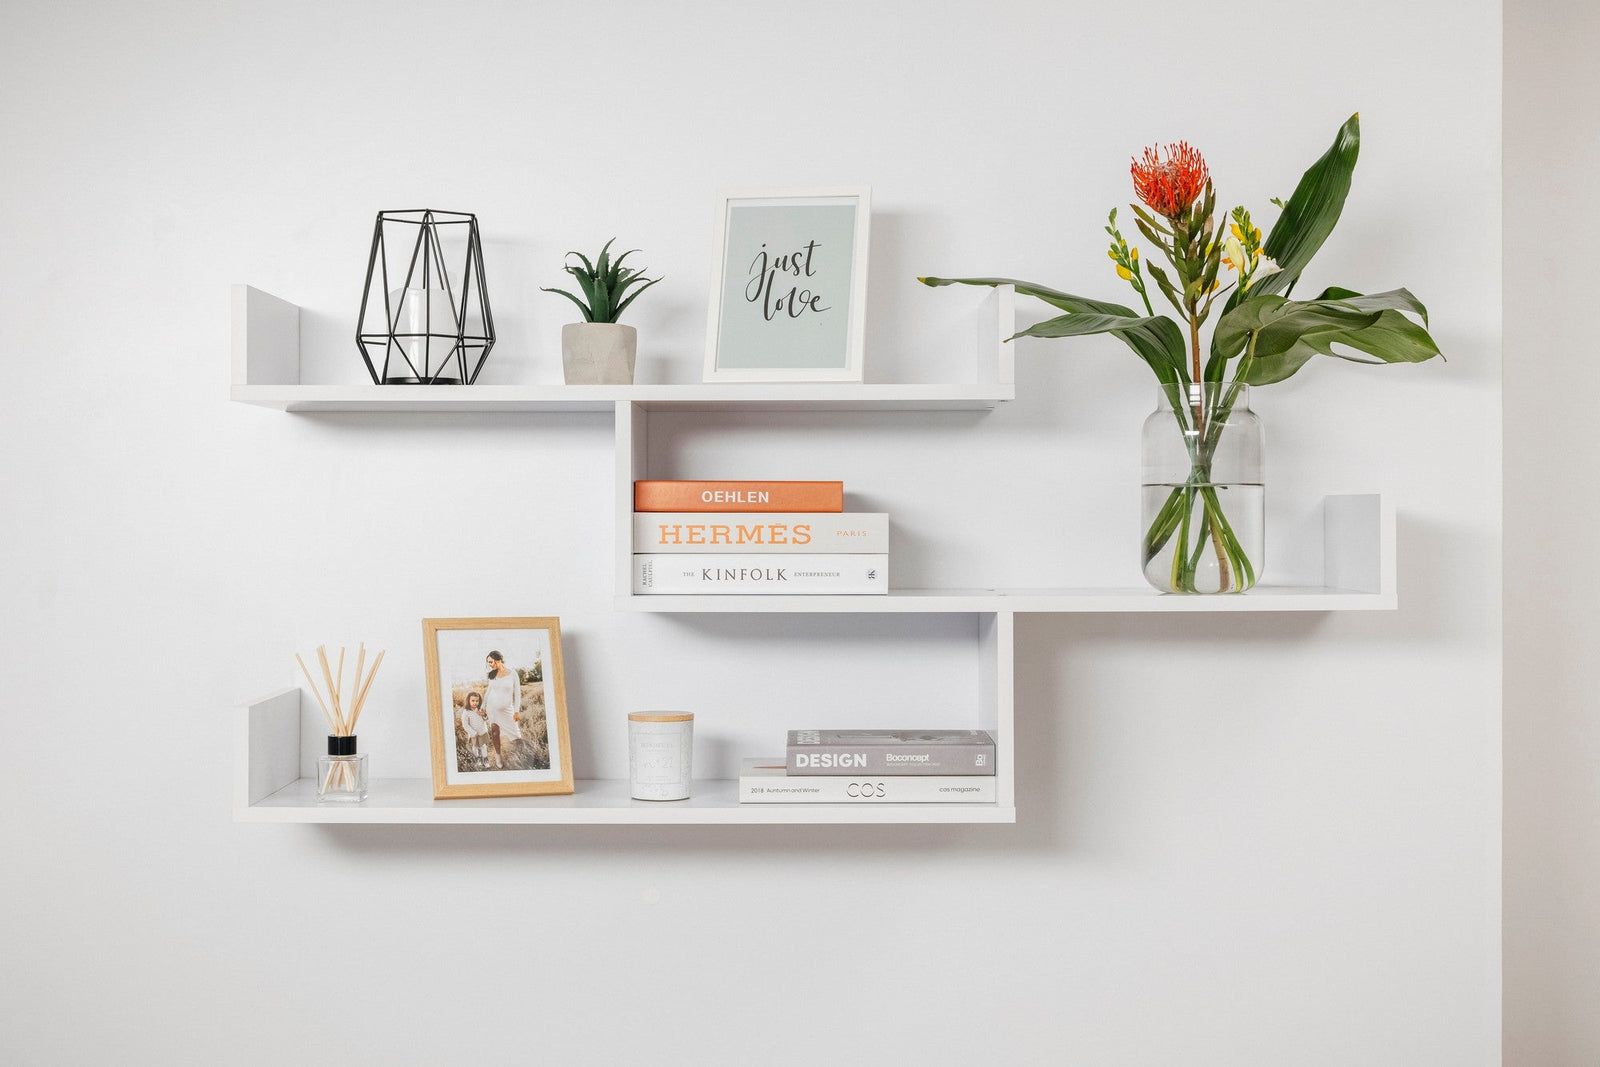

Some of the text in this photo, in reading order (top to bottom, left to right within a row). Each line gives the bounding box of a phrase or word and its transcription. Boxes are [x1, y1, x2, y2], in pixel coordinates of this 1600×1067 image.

[745, 239, 822, 303] just
[763, 269, 832, 322] love
[701, 490, 769, 503] OEHLEN
[702, 568, 788, 581] KINFOLK
[796, 753, 867, 768] DESIGN
[886, 753, 930, 763] Boconcept
[846, 782, 886, 798] COS
[951, 786, 981, 795] magazine
